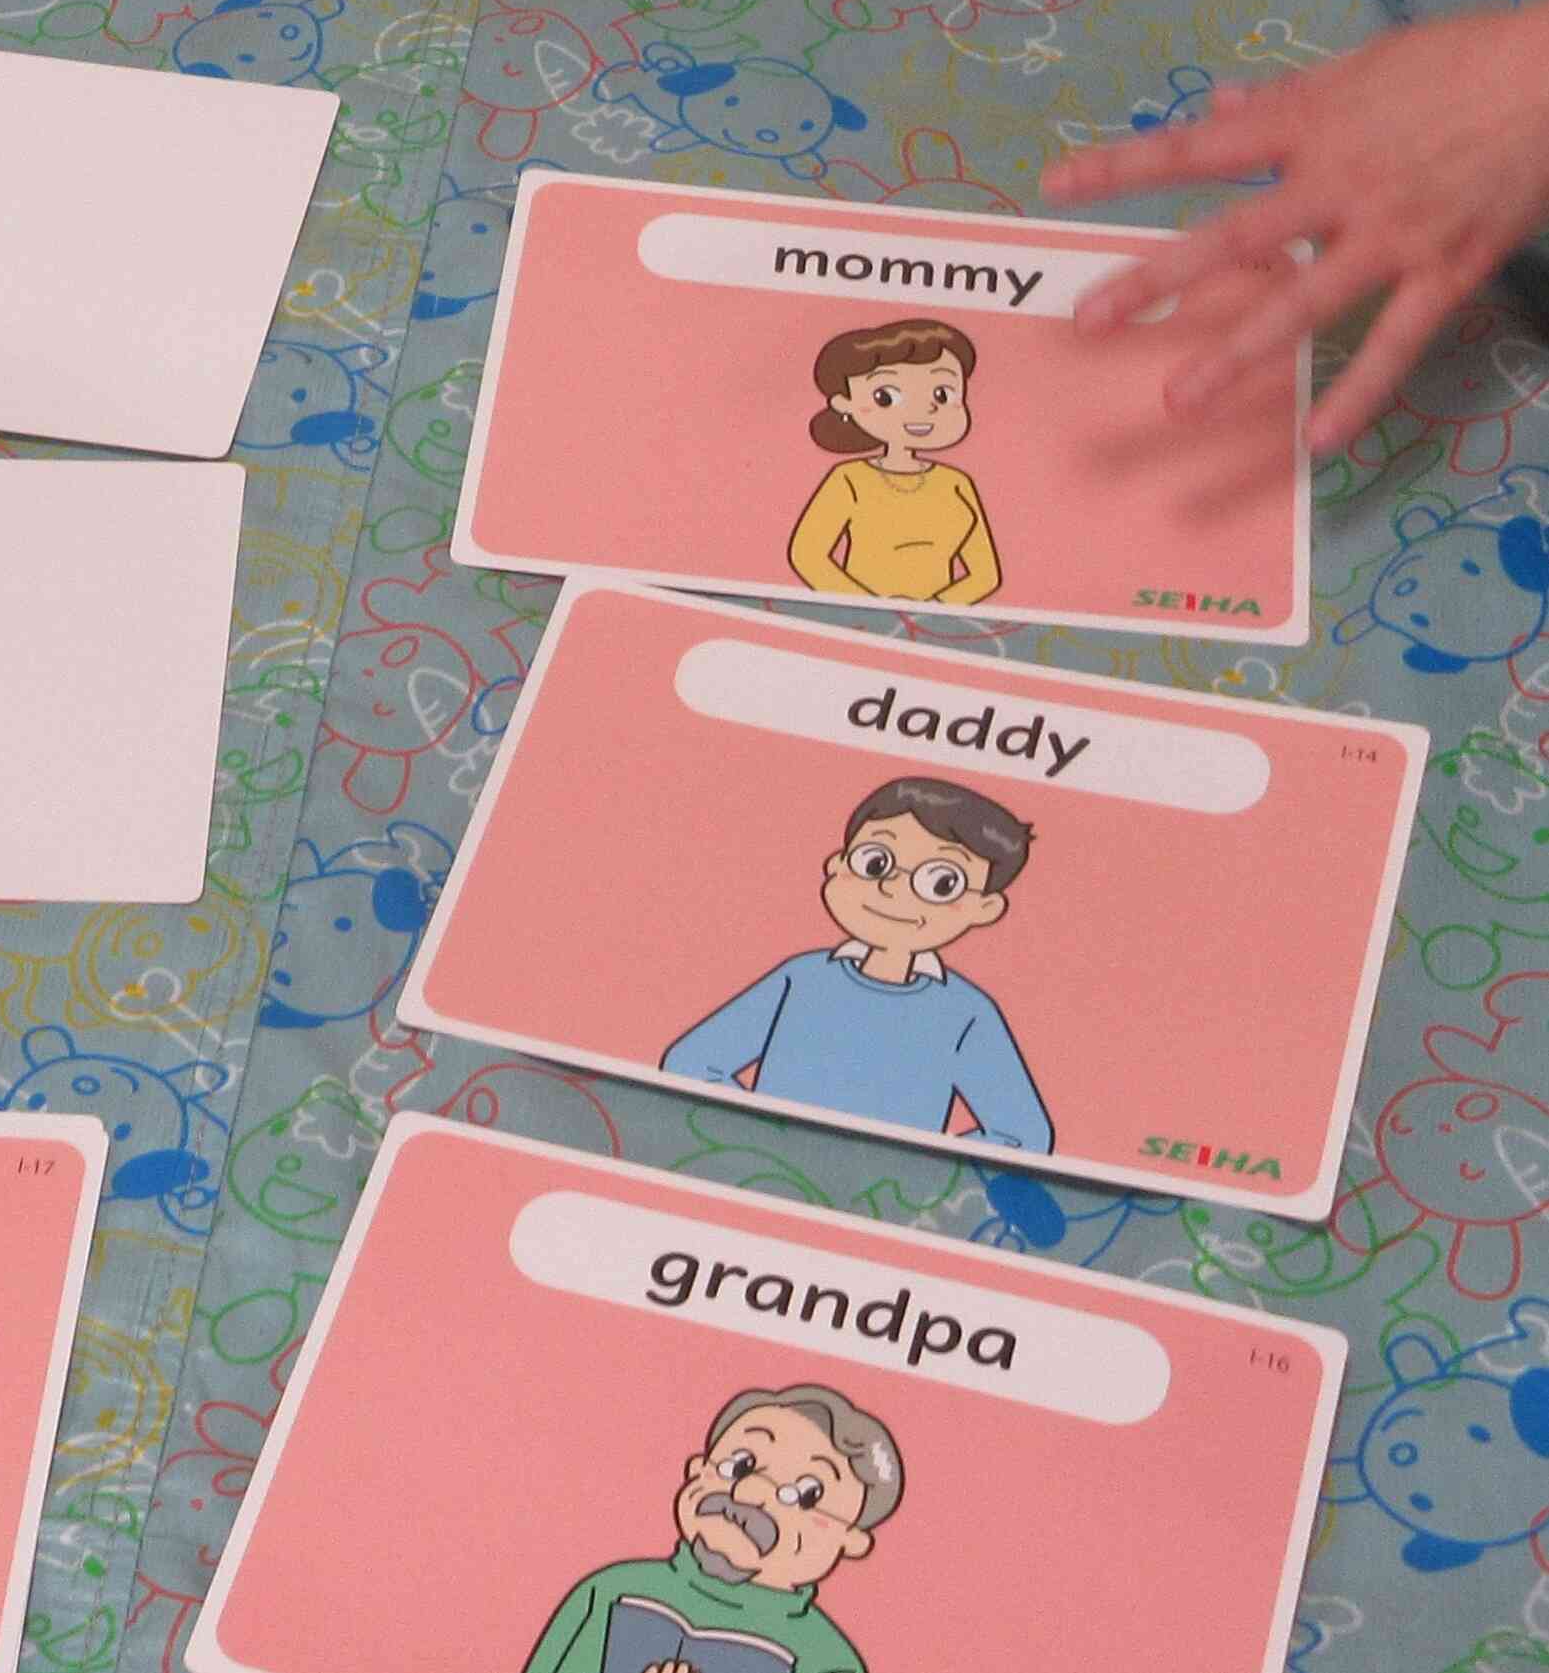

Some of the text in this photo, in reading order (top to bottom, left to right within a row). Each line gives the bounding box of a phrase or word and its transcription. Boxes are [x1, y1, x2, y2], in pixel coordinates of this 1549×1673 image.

[773, 243, 1043, 308] mommy
[1131, 589, 1262, 617] SEIHA
[847, 686, 1091, 779] daddy
[1138, 1136, 1282, 1181] SEIHA
[646, 1250, 1019, 1371] grandpa
